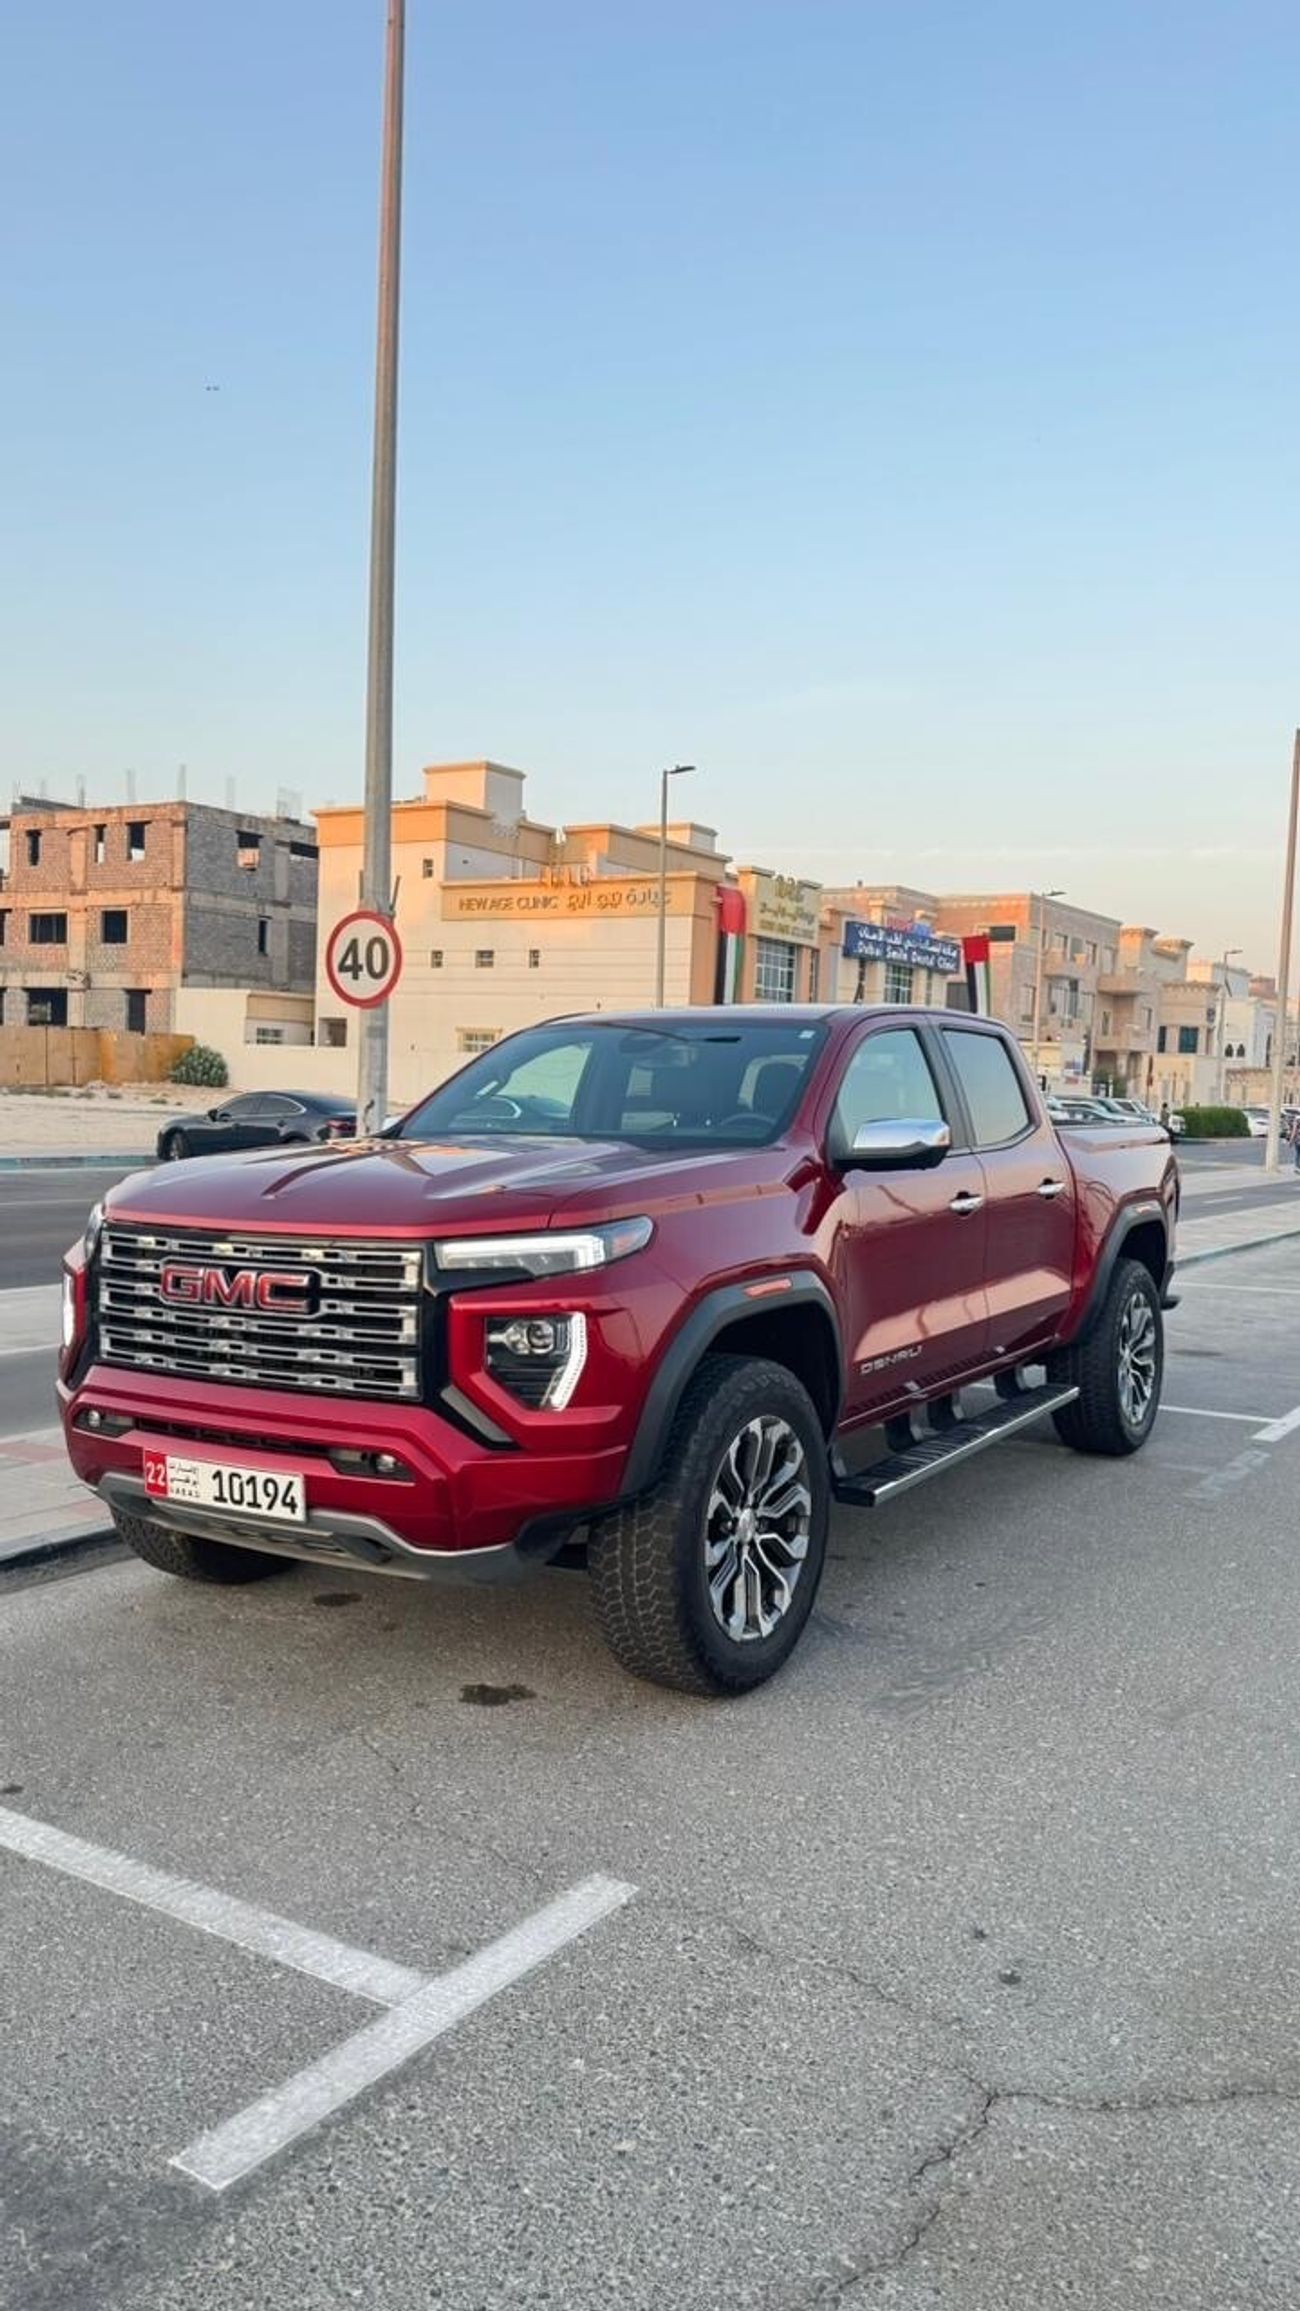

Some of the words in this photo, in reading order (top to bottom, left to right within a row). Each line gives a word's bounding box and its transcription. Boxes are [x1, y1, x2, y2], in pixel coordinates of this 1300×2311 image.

[459, 896, 487, 911] NEW
[489, 897, 514, 911] AGE
[516, 896, 560, 910] CLINIC
[338, 936, 389, 980] 40
[160, 1264, 310, 1314] GMC
[860, 1344, 922, 1375] DENALI
[146, 1461, 166, 1486] 22
[212, 1469, 298, 1515] 10194
